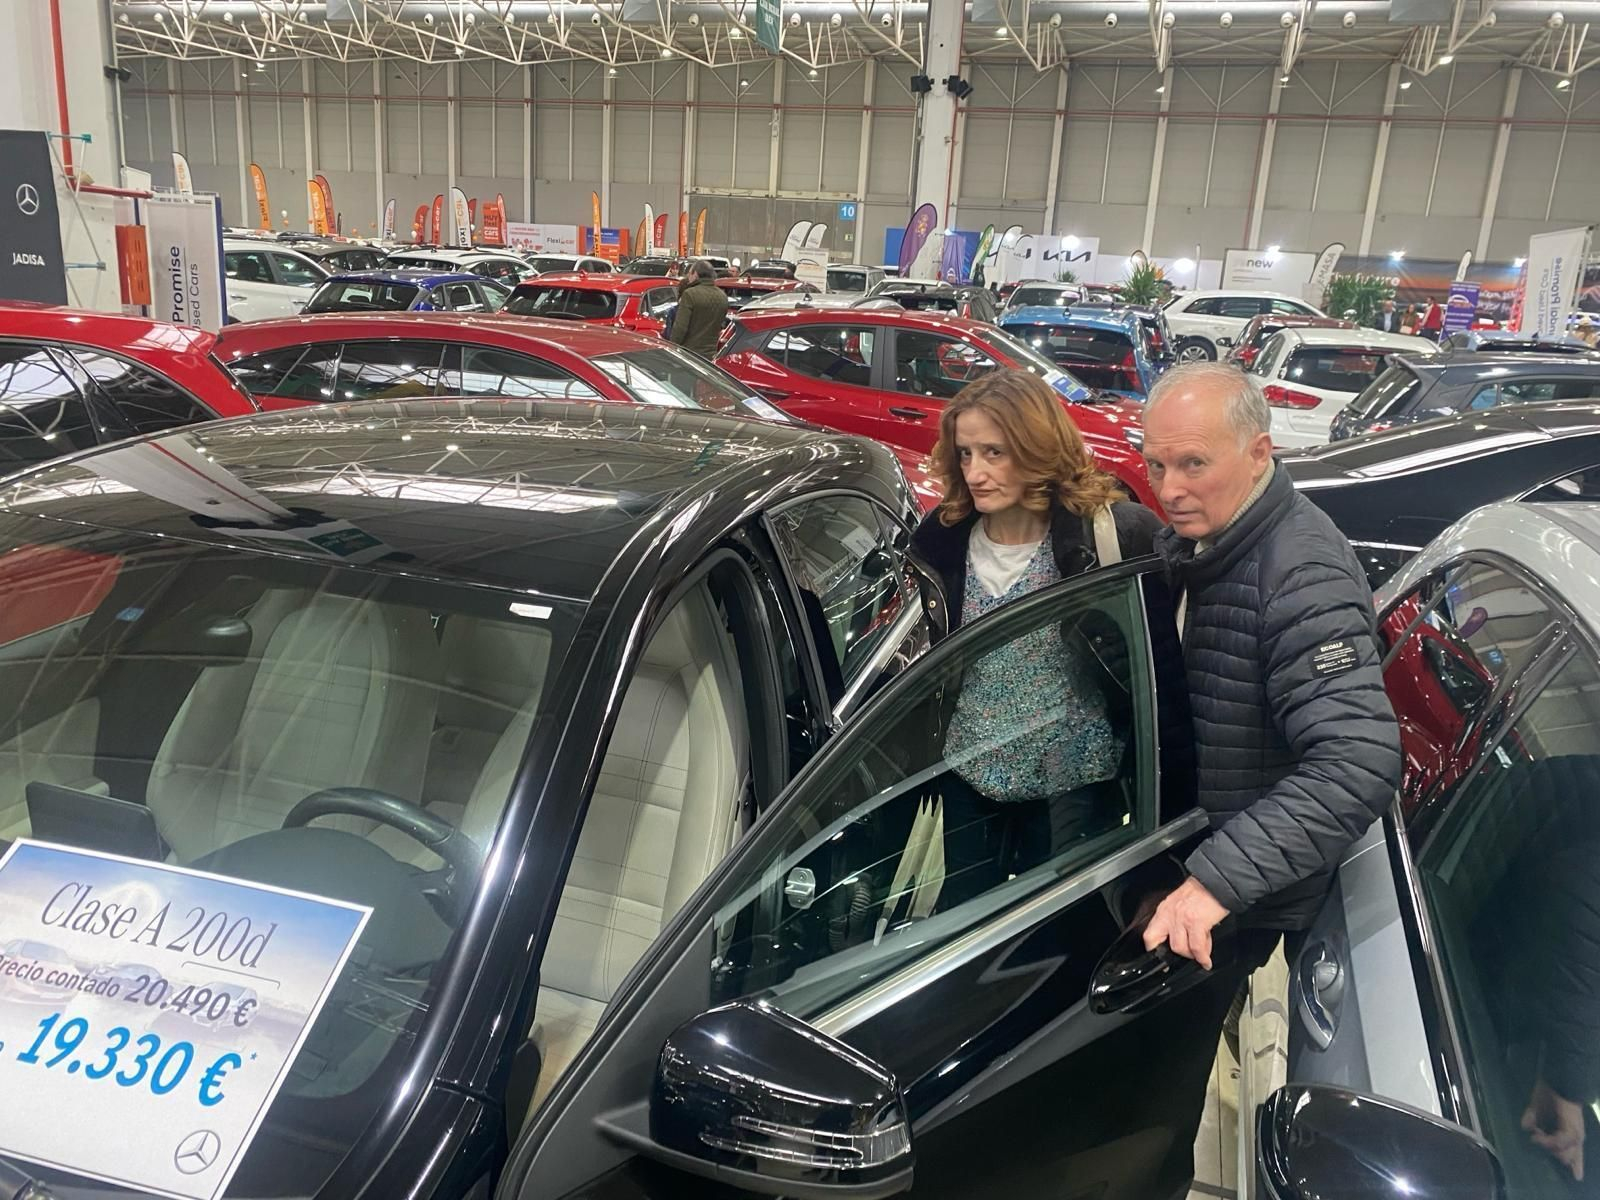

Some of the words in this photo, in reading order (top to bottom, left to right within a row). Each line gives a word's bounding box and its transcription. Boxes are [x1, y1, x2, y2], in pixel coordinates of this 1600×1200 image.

[841, 206, 855, 217] 10
[12, 252, 46, 267] JADISA
[168, 245, 185, 323] Promise
[189, 263, 199, 296] Cars
[41, 881, 137, 940] Clase
[130, 902, 173, 947] A
[166, 907, 278, 968] 200d
[45, 970, 120, 998] contado
[125, 975, 231, 1021] 20.490
[234, 998, 257, 1027] €
[16, 1012, 195, 1095] 19.330
